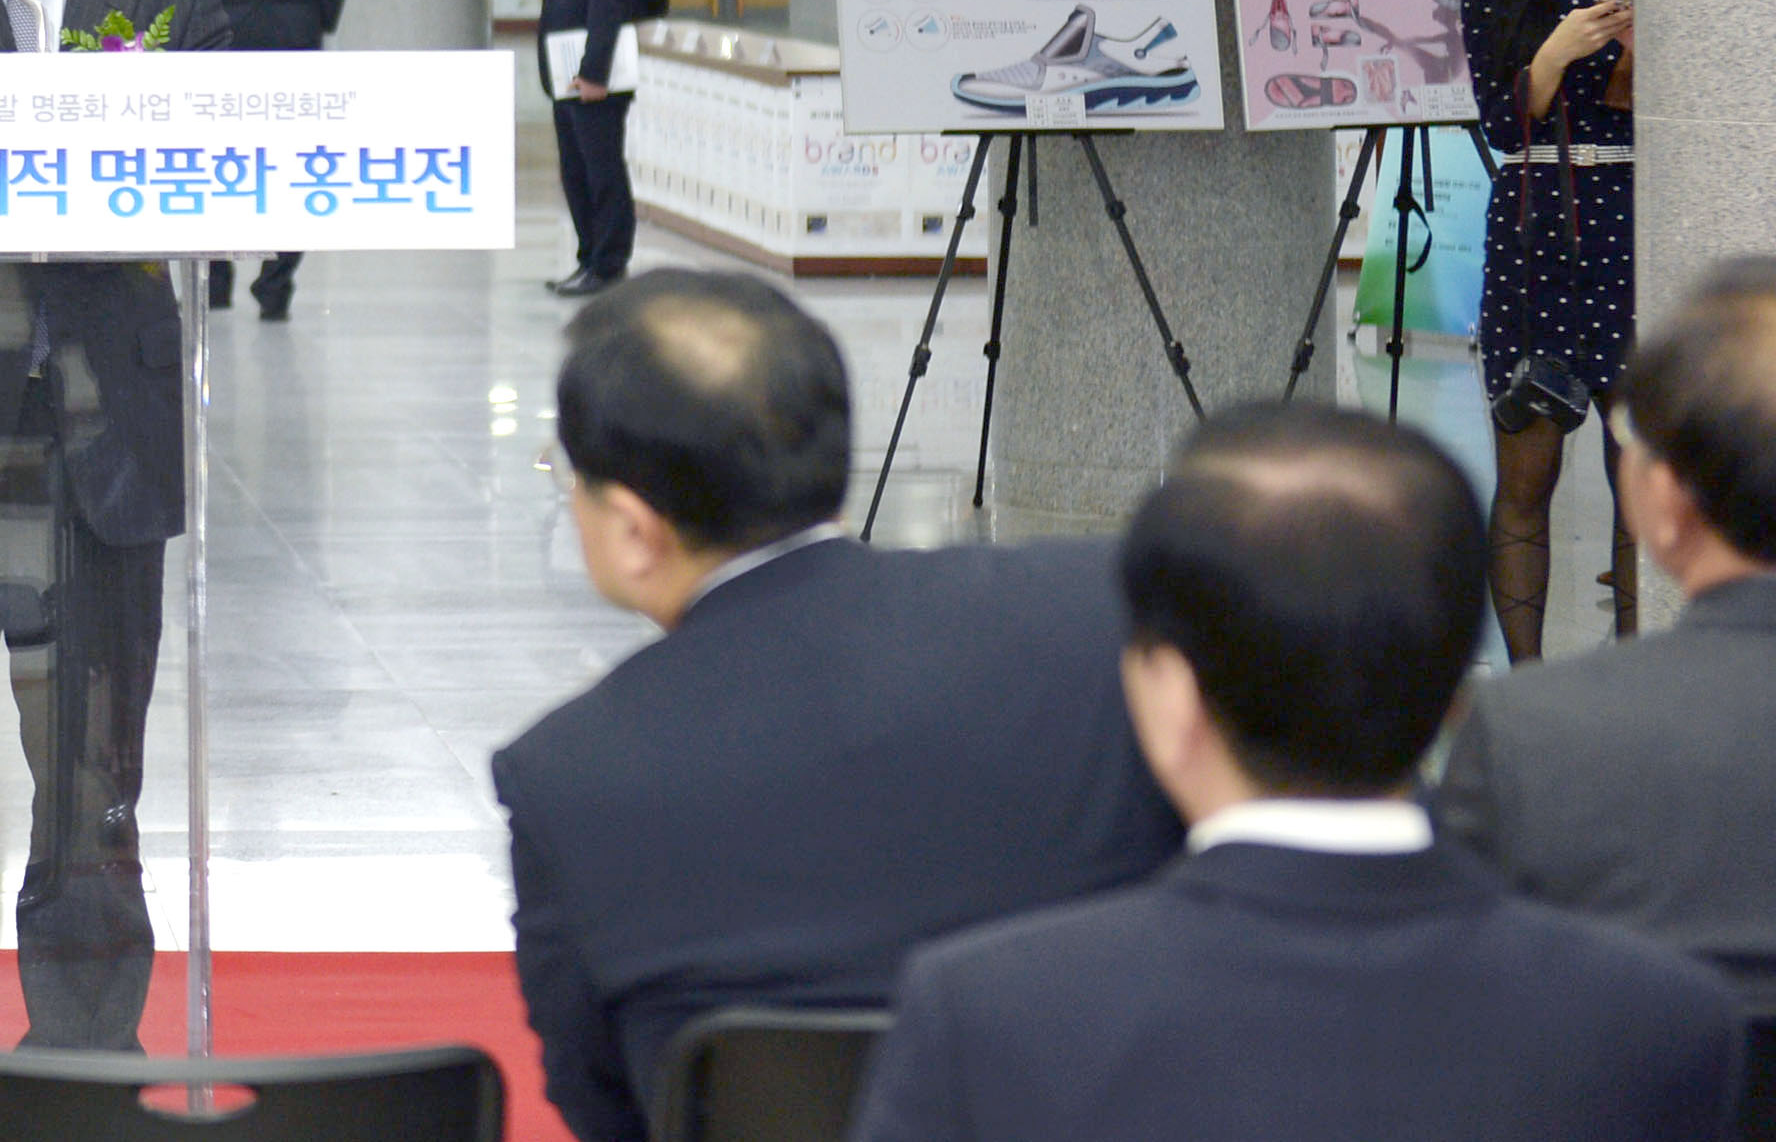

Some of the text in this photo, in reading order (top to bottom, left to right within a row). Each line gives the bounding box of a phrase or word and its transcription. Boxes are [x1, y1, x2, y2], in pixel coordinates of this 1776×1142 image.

[31, 93, 110, 123] 명품화
[120, 92, 171, 122] 사업
[90, 146, 278, 219] 명품화
[289, 144, 473, 218] 홍보전
